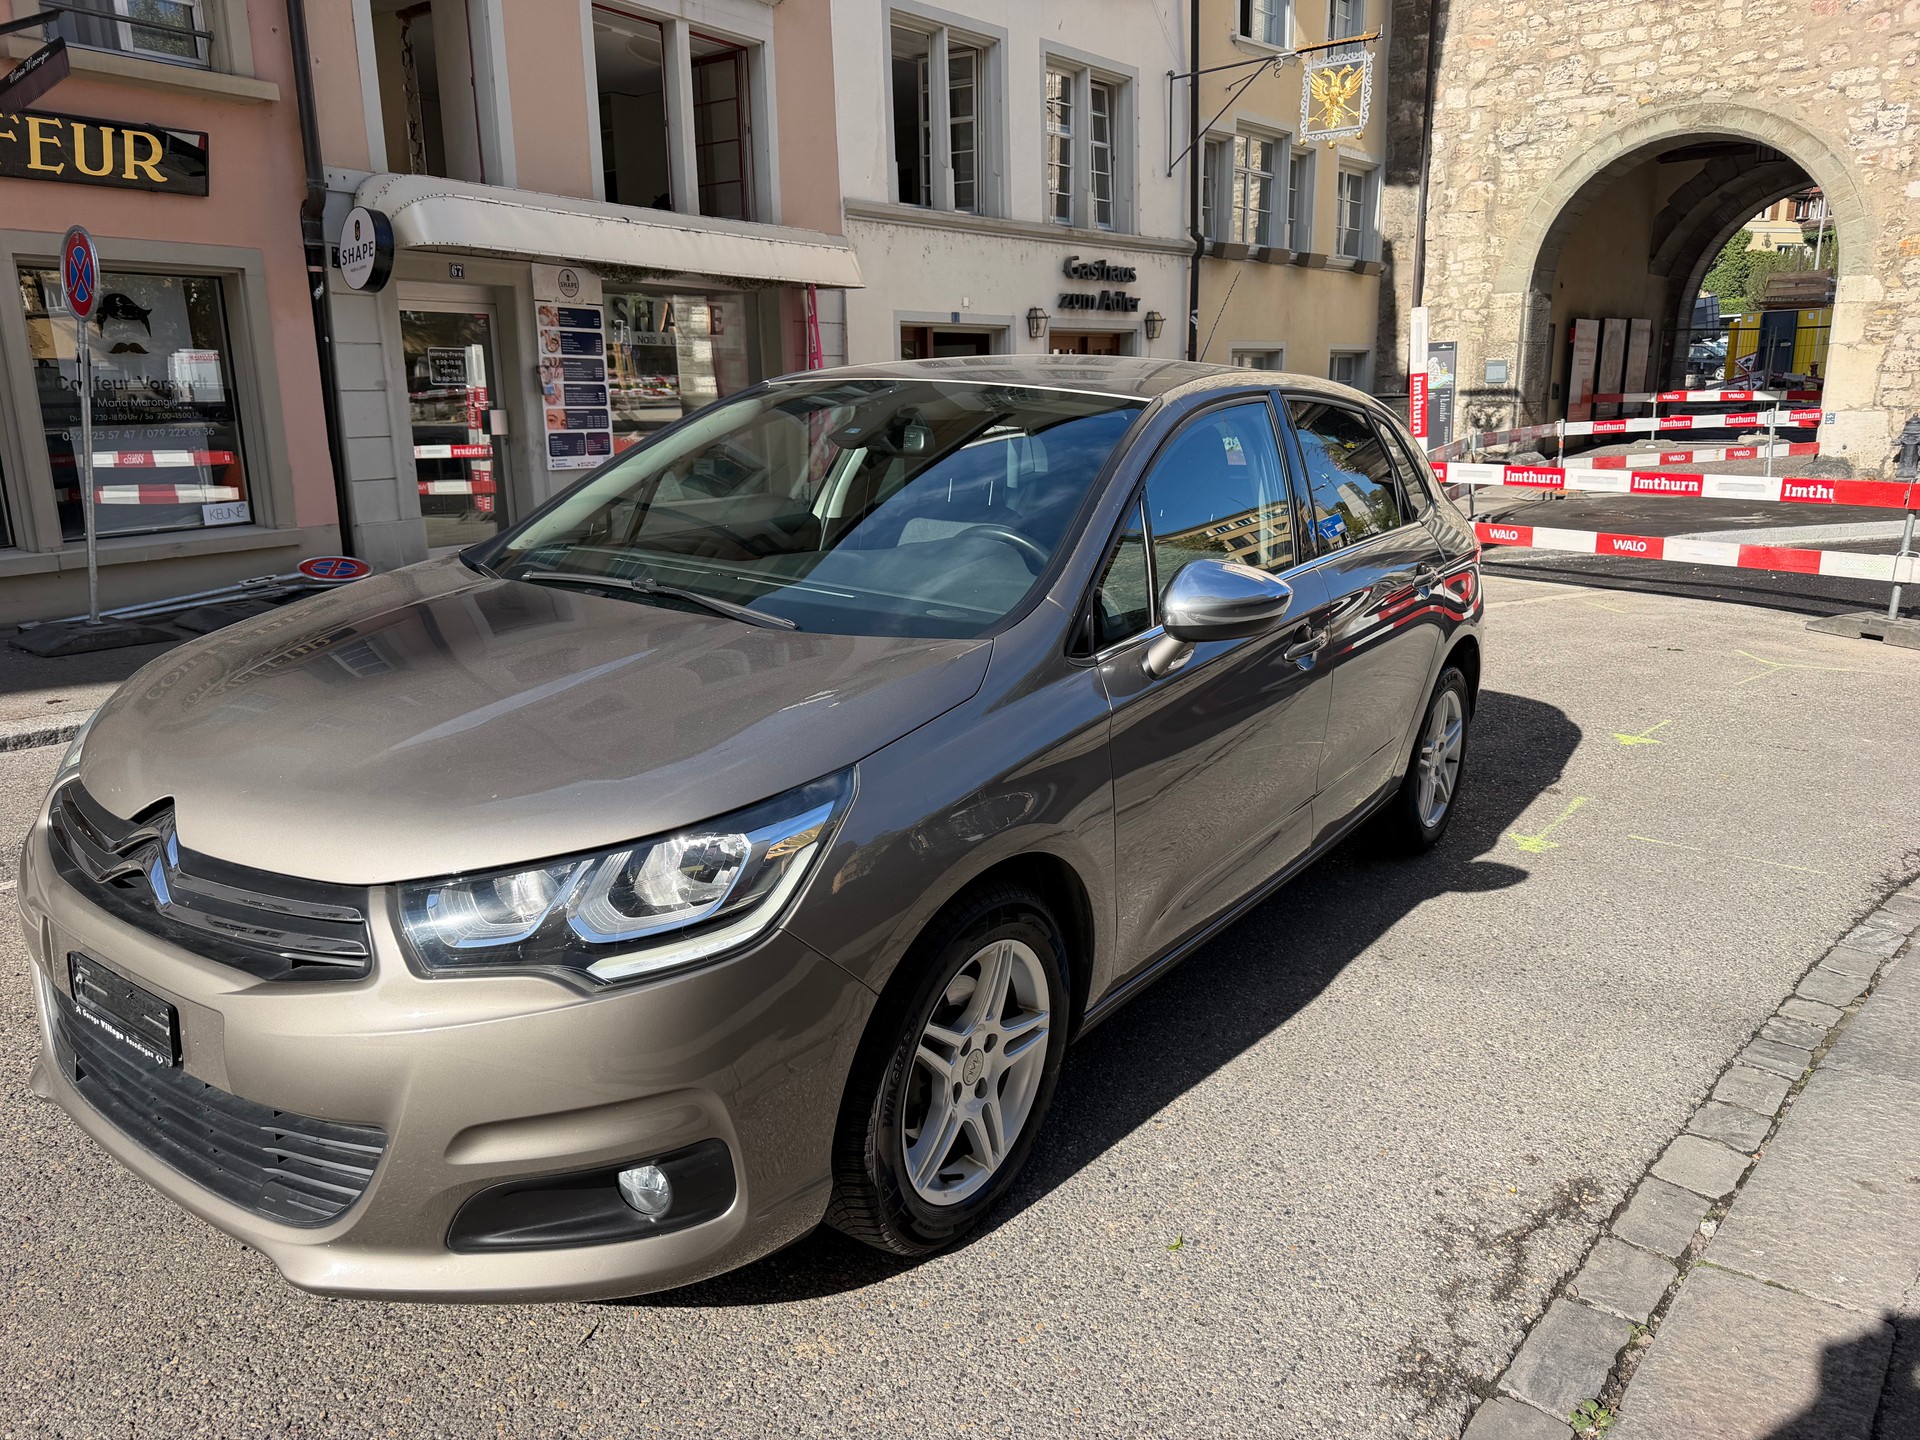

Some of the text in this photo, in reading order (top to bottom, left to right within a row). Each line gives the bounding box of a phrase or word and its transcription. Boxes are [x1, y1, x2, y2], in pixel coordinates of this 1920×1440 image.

[342, 241, 374, 266] SHAPE
[451, 265, 462, 277] 67
[1062, 255, 1137, 282] Gasthaus
[560, 281, 577, 289] SHAPE
[1058, 290, 1141, 312] zum Adler
[611, 297, 724, 336] SHAE
[56, 375, 130, 391] Cofeur
[97, 397, 178, 408] Maria Marongiu
[1413, 376, 1423, 435] Imthurn
[1593, 423, 1625, 432] Imthurn
[1660, 419, 1691, 428] Imthurn
[1726, 415, 1756, 424] Imthurn
[1790, 412, 1820, 421] Imthurn
[108, 430, 120, 440] 57
[123, 430, 135, 440] 47
[147, 429, 165, 439] 079
[168, 428, 186, 438] 222
[1668, 449, 1750, 462] WALO WALO
[1506, 470, 1562, 484] Imthurn
[1633, 476, 1699, 492] Imthurn
[209, 507, 244, 520] KEUNE
[1489, 528, 1647, 552] WALO WALO
